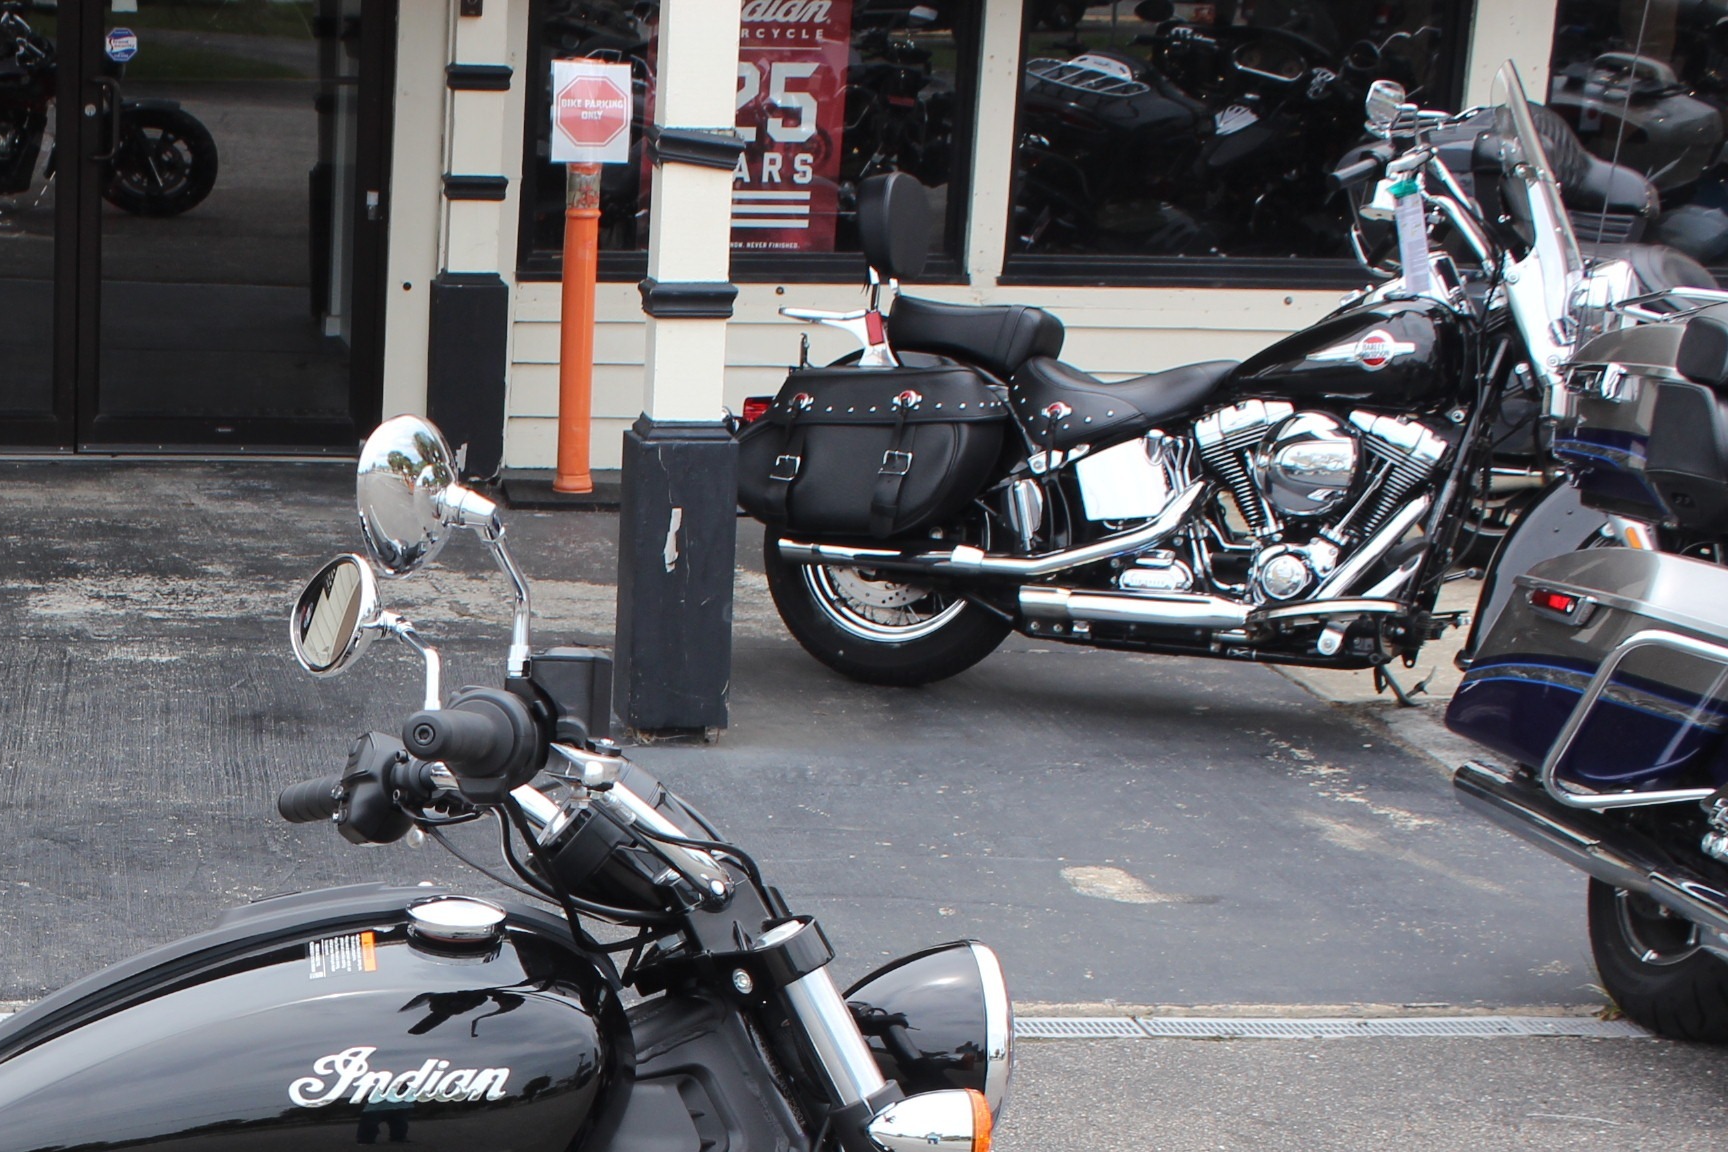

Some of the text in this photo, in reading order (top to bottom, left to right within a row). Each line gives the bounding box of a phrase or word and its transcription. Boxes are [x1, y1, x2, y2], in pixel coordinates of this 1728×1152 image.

[561, 98, 624, 109] BIKE PARKING
[581, 110, 603, 120] ONLY
[288, 1046, 511, 1108] Indian
